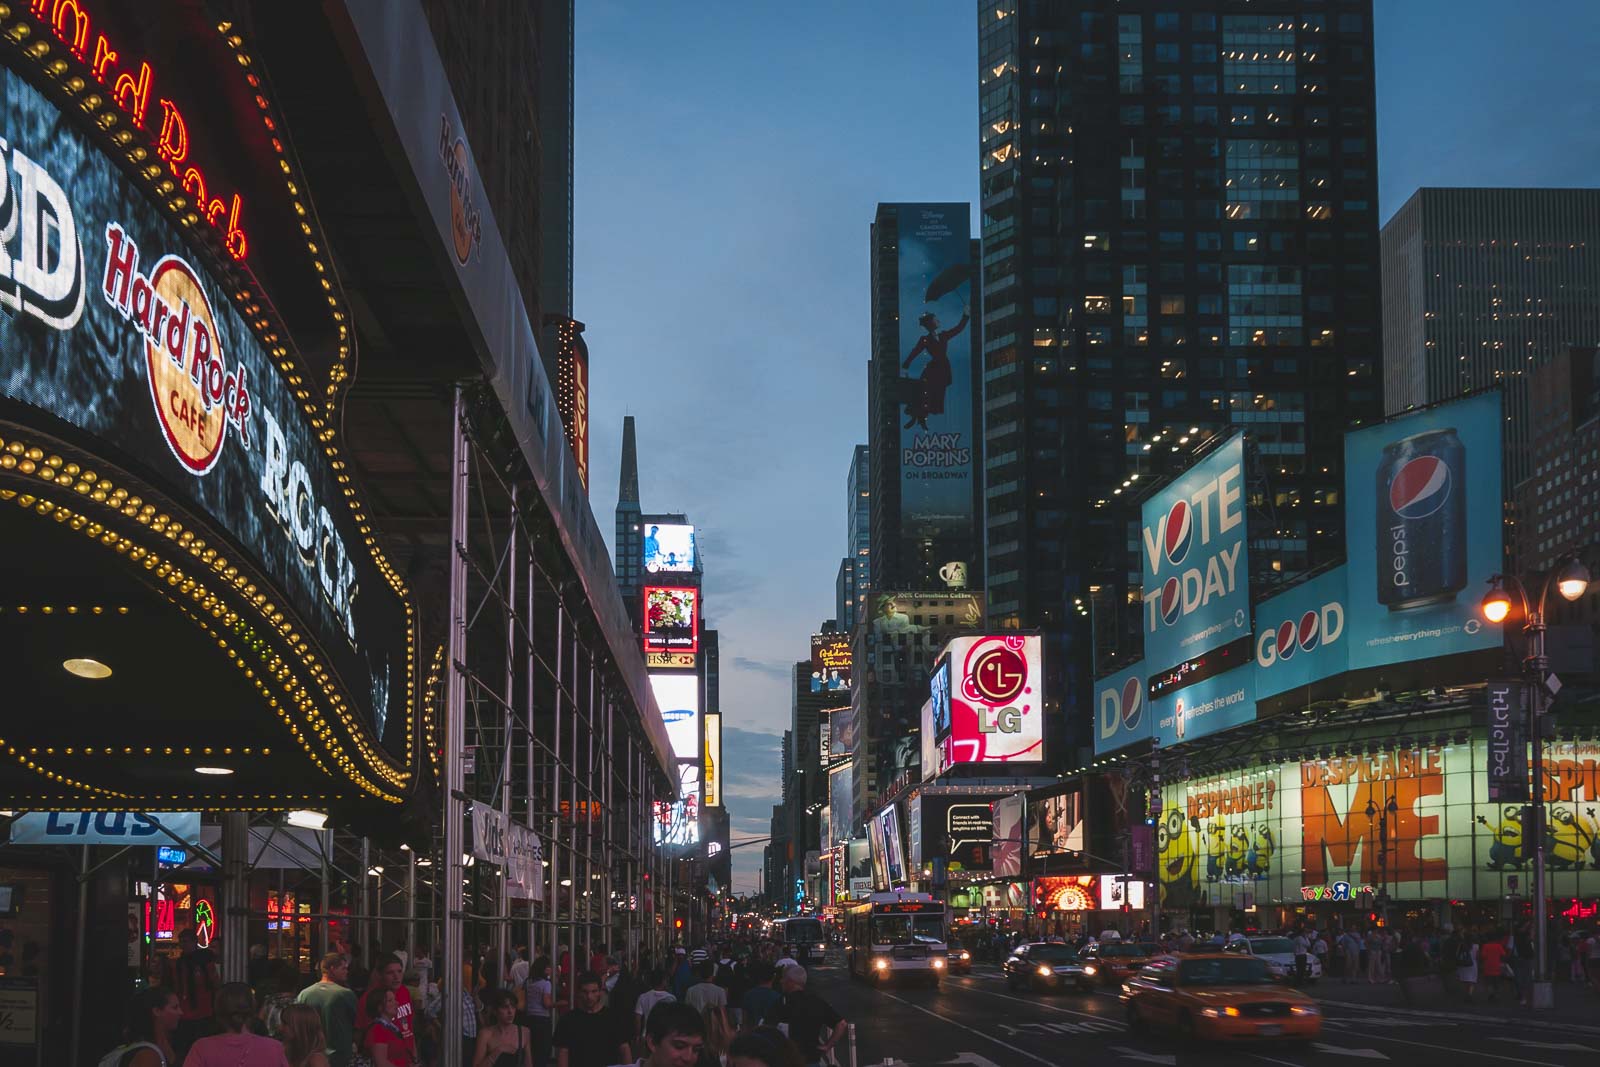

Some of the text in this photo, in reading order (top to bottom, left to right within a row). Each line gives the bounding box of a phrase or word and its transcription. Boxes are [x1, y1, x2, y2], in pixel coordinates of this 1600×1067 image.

[103, 222, 250, 449] Hard Rock
[170, 390, 206, 442] CAFE
[904, 448, 970, 467] POPPINS
[913, 433, 960, 450] MARY
[905, 471, 968, 480] ON BROADWAY
[1391, 524, 1409, 586] pepsi
[978, 707, 1021, 733] LG
[1160, 688, 1245, 728] every refreshes the world
[1301, 746, 1442, 787] DESPICABLE
[1302, 775, 1447, 885] ME
